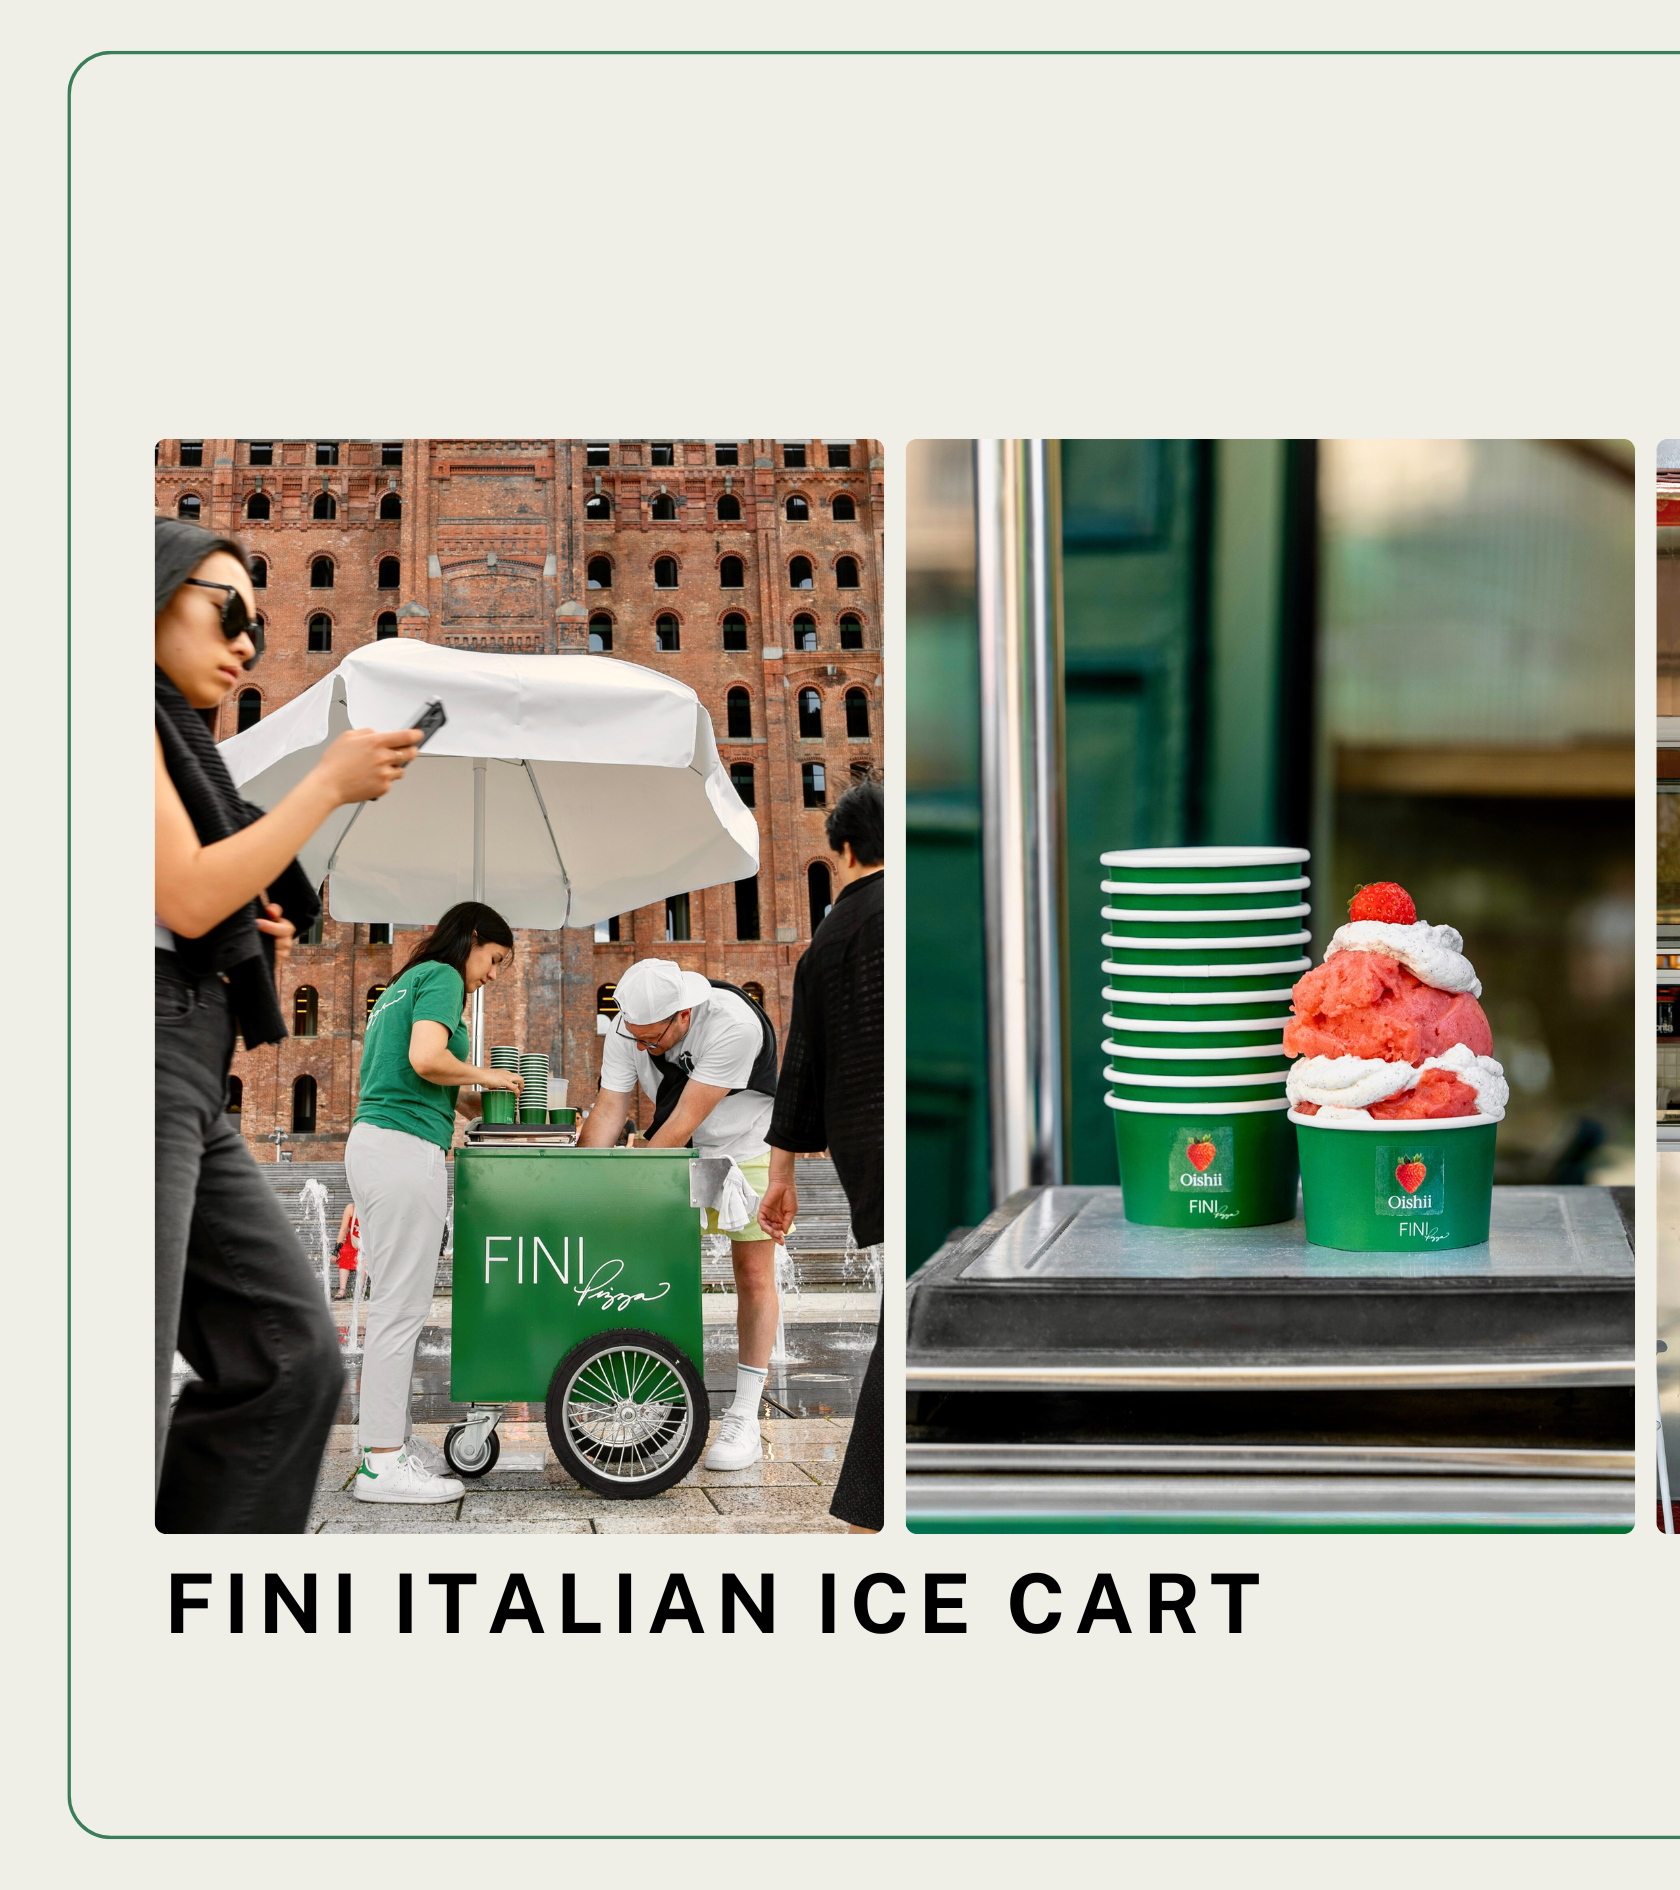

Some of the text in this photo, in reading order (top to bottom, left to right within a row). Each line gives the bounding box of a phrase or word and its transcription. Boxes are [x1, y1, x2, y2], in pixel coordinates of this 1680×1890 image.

[1180, 1173, 1222, 1187] Oishii
[1189, 1199, 1218, 1214] FINI
[1388, 1194, 1432, 1209] Oishii
[1400, 1222, 1429, 1237] FINI
[485, 1236, 671, 1311] FINI Pizza
